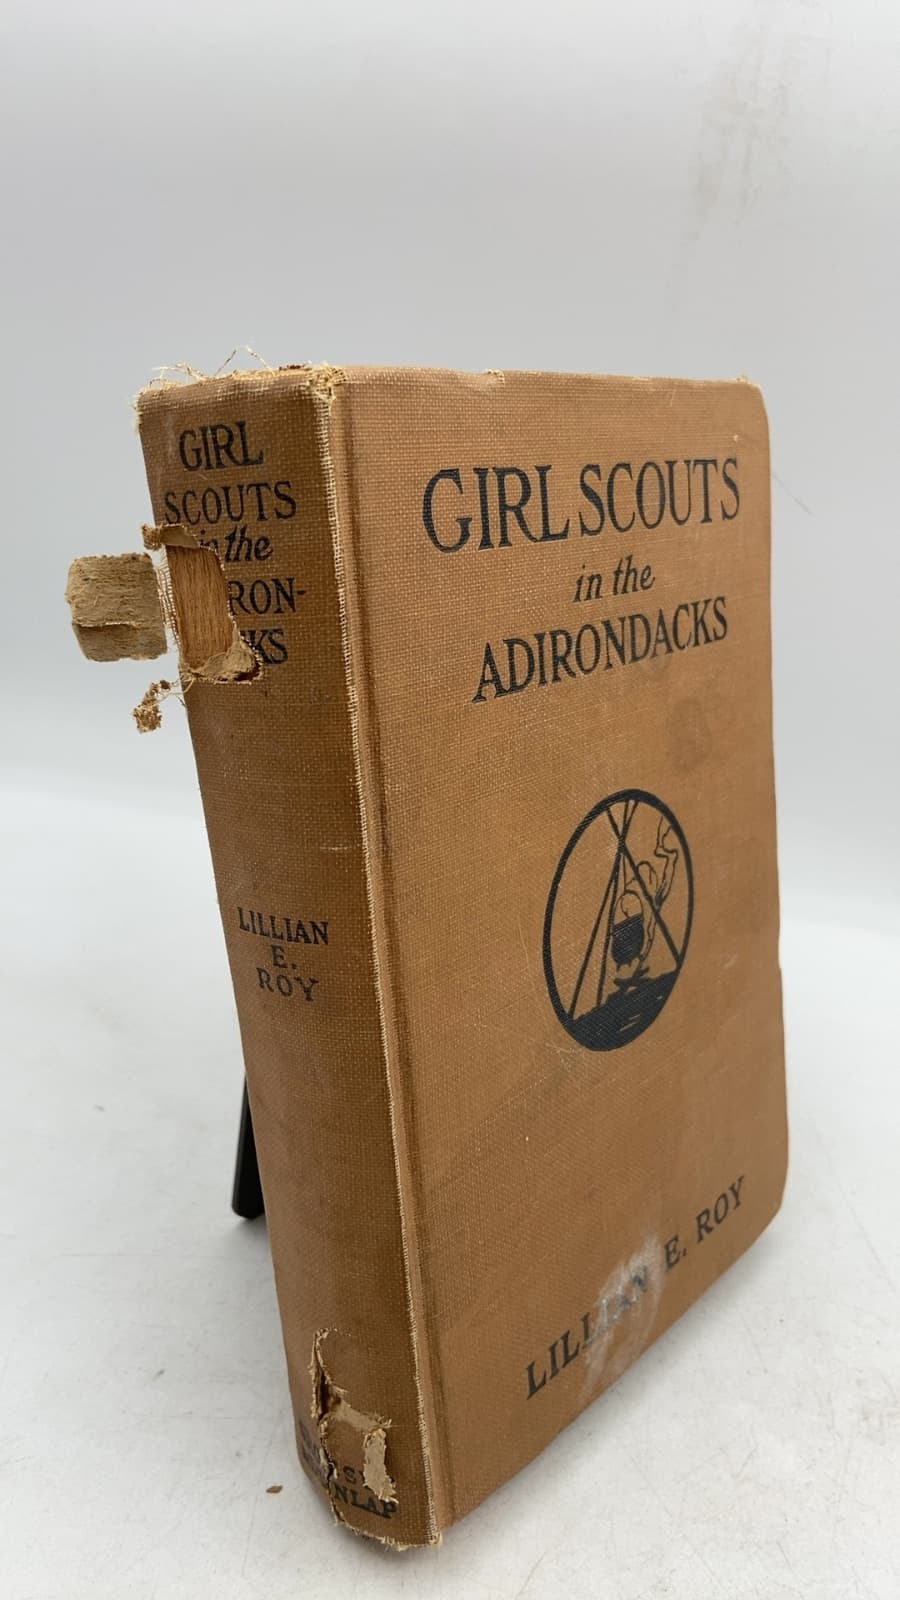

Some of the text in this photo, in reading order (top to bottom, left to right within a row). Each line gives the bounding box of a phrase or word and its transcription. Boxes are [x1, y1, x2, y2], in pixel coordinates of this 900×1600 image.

[179, 420, 263, 471] GIRL
[164, 480, 296, 525] SCOUTS
[422, 457, 740, 553] GIRL SCOUTS
[224, 525, 273, 563] the
[228, 577, 307, 615] RON-
[572, 554, 656, 603] in the
[471, 596, 728, 704] ADIRONDACKS
[237, 906, 329, 945] LILLIAN
[271, 944, 297, 969] E.
[256, 967, 319, 1002] ROY
[663, 1234, 688, 1272] E.
[695, 1175, 744, 1243] ROY
